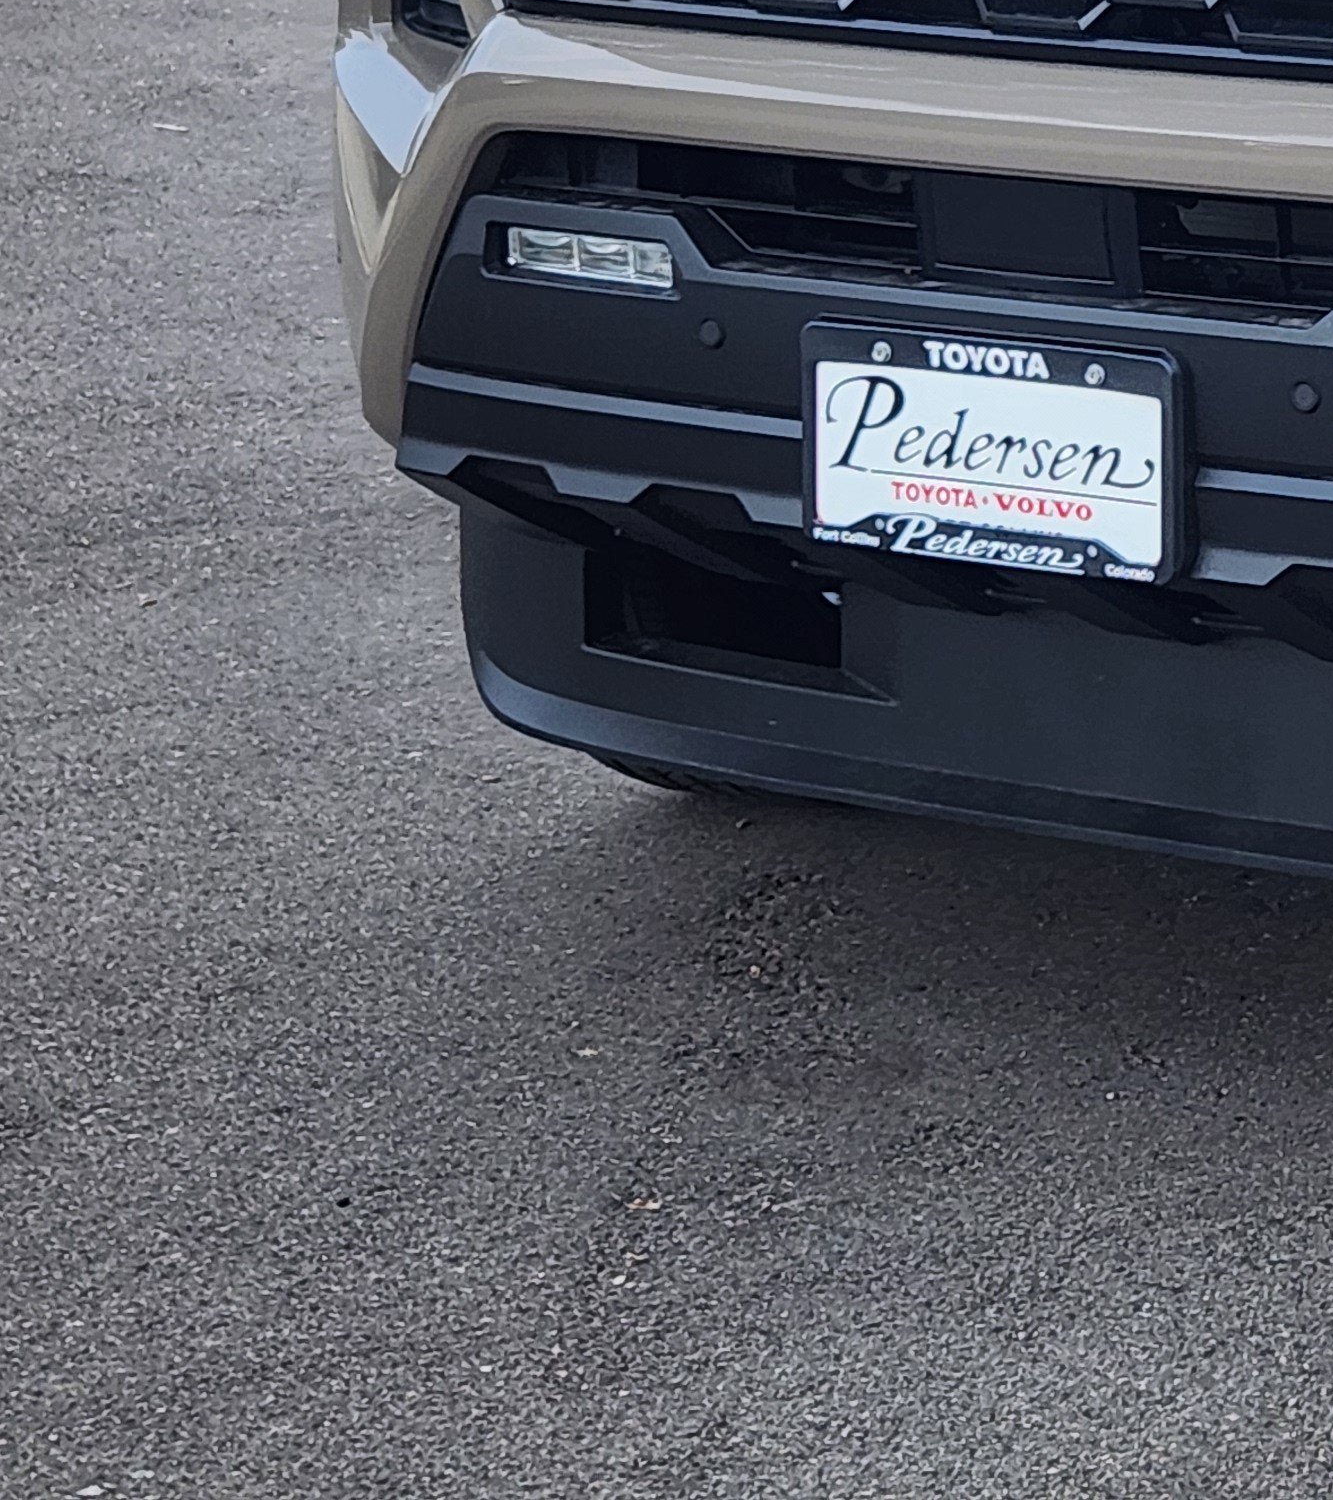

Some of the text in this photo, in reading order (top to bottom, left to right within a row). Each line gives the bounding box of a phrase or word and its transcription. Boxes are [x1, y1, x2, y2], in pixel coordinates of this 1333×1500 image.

[922, 340, 1050, 380] TOYOTA
[826, 375, 1155, 489] Pedersen
[891, 481, 1093, 521] TOYOTA VOLVO
[886, 513, 1084, 567] Pedersen
